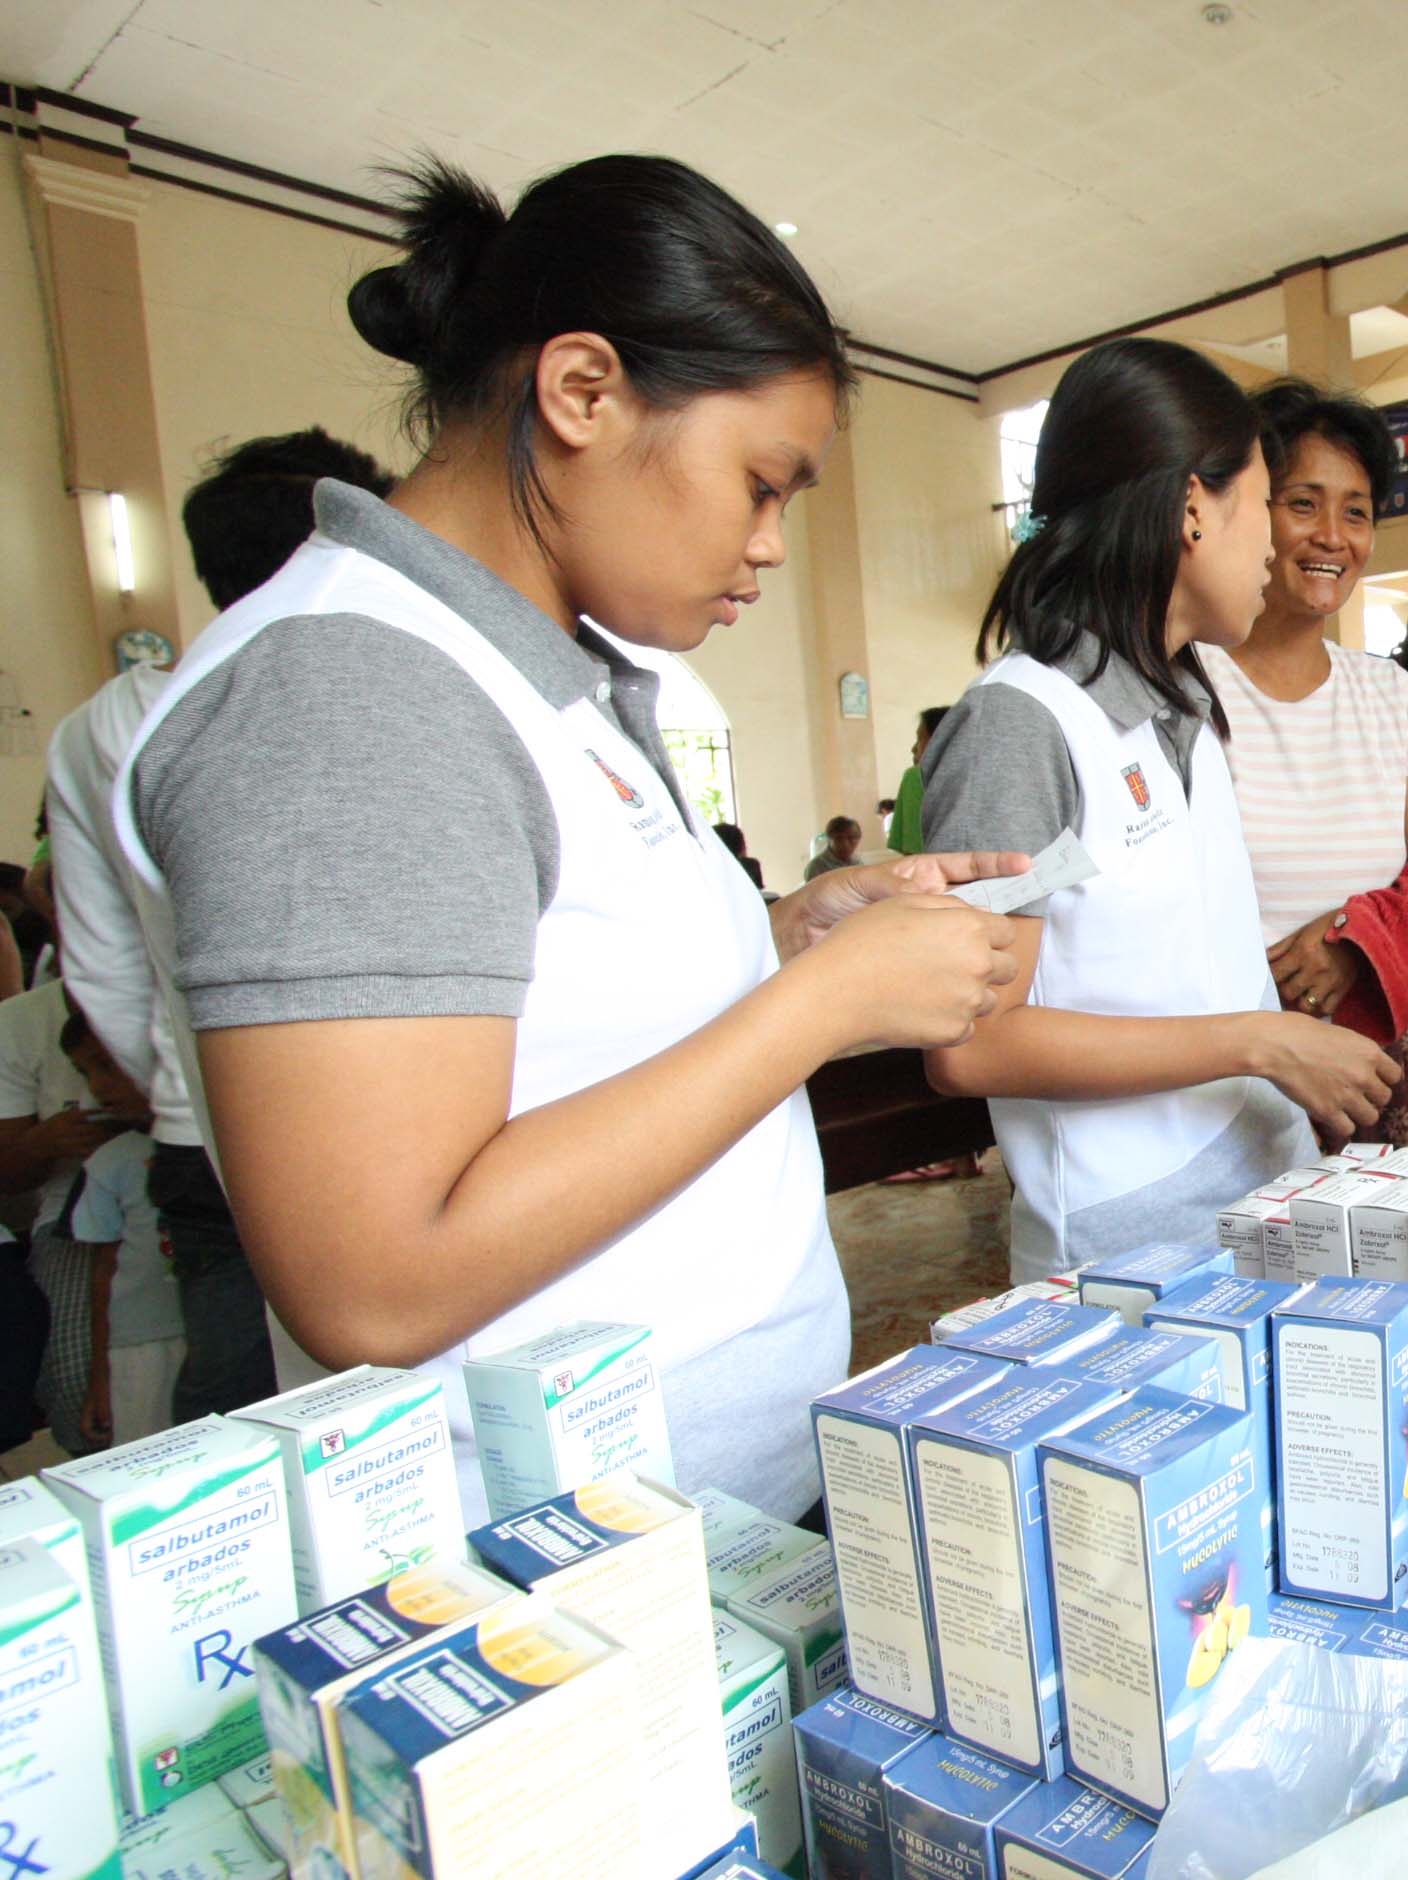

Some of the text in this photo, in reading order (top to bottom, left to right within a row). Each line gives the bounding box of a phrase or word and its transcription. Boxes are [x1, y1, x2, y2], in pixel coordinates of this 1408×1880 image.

[567, 1373, 648, 1424] salbutamol
[990, 1386, 1069, 1433] AMBROXOL
[584, 1404, 638, 1438] arbados
[1119, 1408, 1200, 1458] AMBROXOL
[334, 1430, 438, 1486] salbutamol
[1288, 1443, 1319, 1456] ADVERSE
[236, 1478, 272, 1499] 60 mL
[354, 1465, 425, 1504] arbados
[1167, 1471, 1246, 1530] AMBROXOL
[138, 1502, 271, 1565] salbutamol
[363, 1512, 436, 1551] ANTI-ASTHMA
[365, 1497, 425, 1533] Syrup
[162, 1538, 252, 1583] arbados
[1183, 1526, 1239, 1575] MUCOLYTIC
[170, 1590, 263, 1634] ANTI-ASTHMA
[172, 1575, 249, 1615] Syrup
[752, 1687, 779, 1708] 60 mL
[848, 1692, 919, 1733] AMBROXOL
[806, 1770, 874, 1813] AMBROXOL
[937, 1760, 1000, 1793] MUCOLYTIC
[818, 1820, 869, 1850] MUCOLYTIC
[897, 1829, 974, 1875] AMBROXOL
